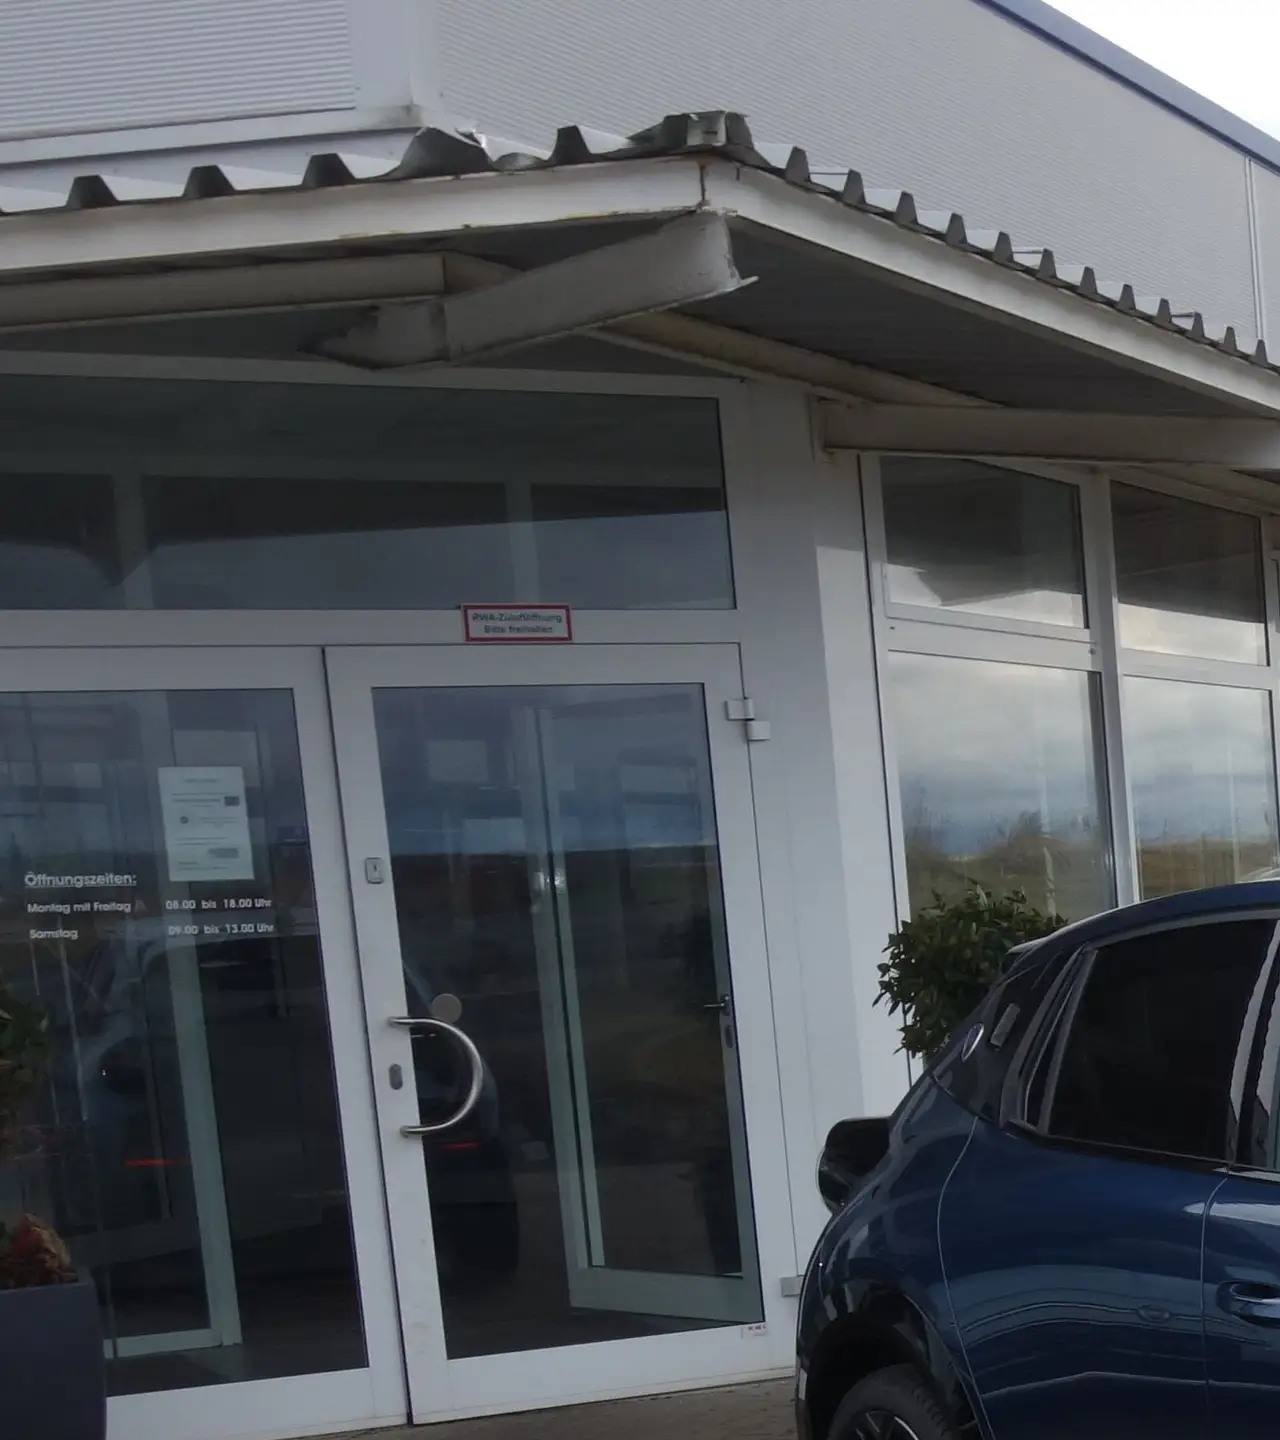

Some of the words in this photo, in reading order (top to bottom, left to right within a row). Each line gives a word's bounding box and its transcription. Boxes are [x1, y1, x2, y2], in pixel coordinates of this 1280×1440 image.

[24, 871, 137, 889] Öffnungszeiten:
[27, 903, 71, 914] Montag
[94, 901, 132, 914] Freitag
[201, 899, 217, 909] bis
[223, 898, 252, 908] 18.00
[254, 898, 273, 908] Uhr
[29, 929, 79, 940] Samstag
[204, 924, 219, 934] bis
[257, 923, 275, 933] Uhr
